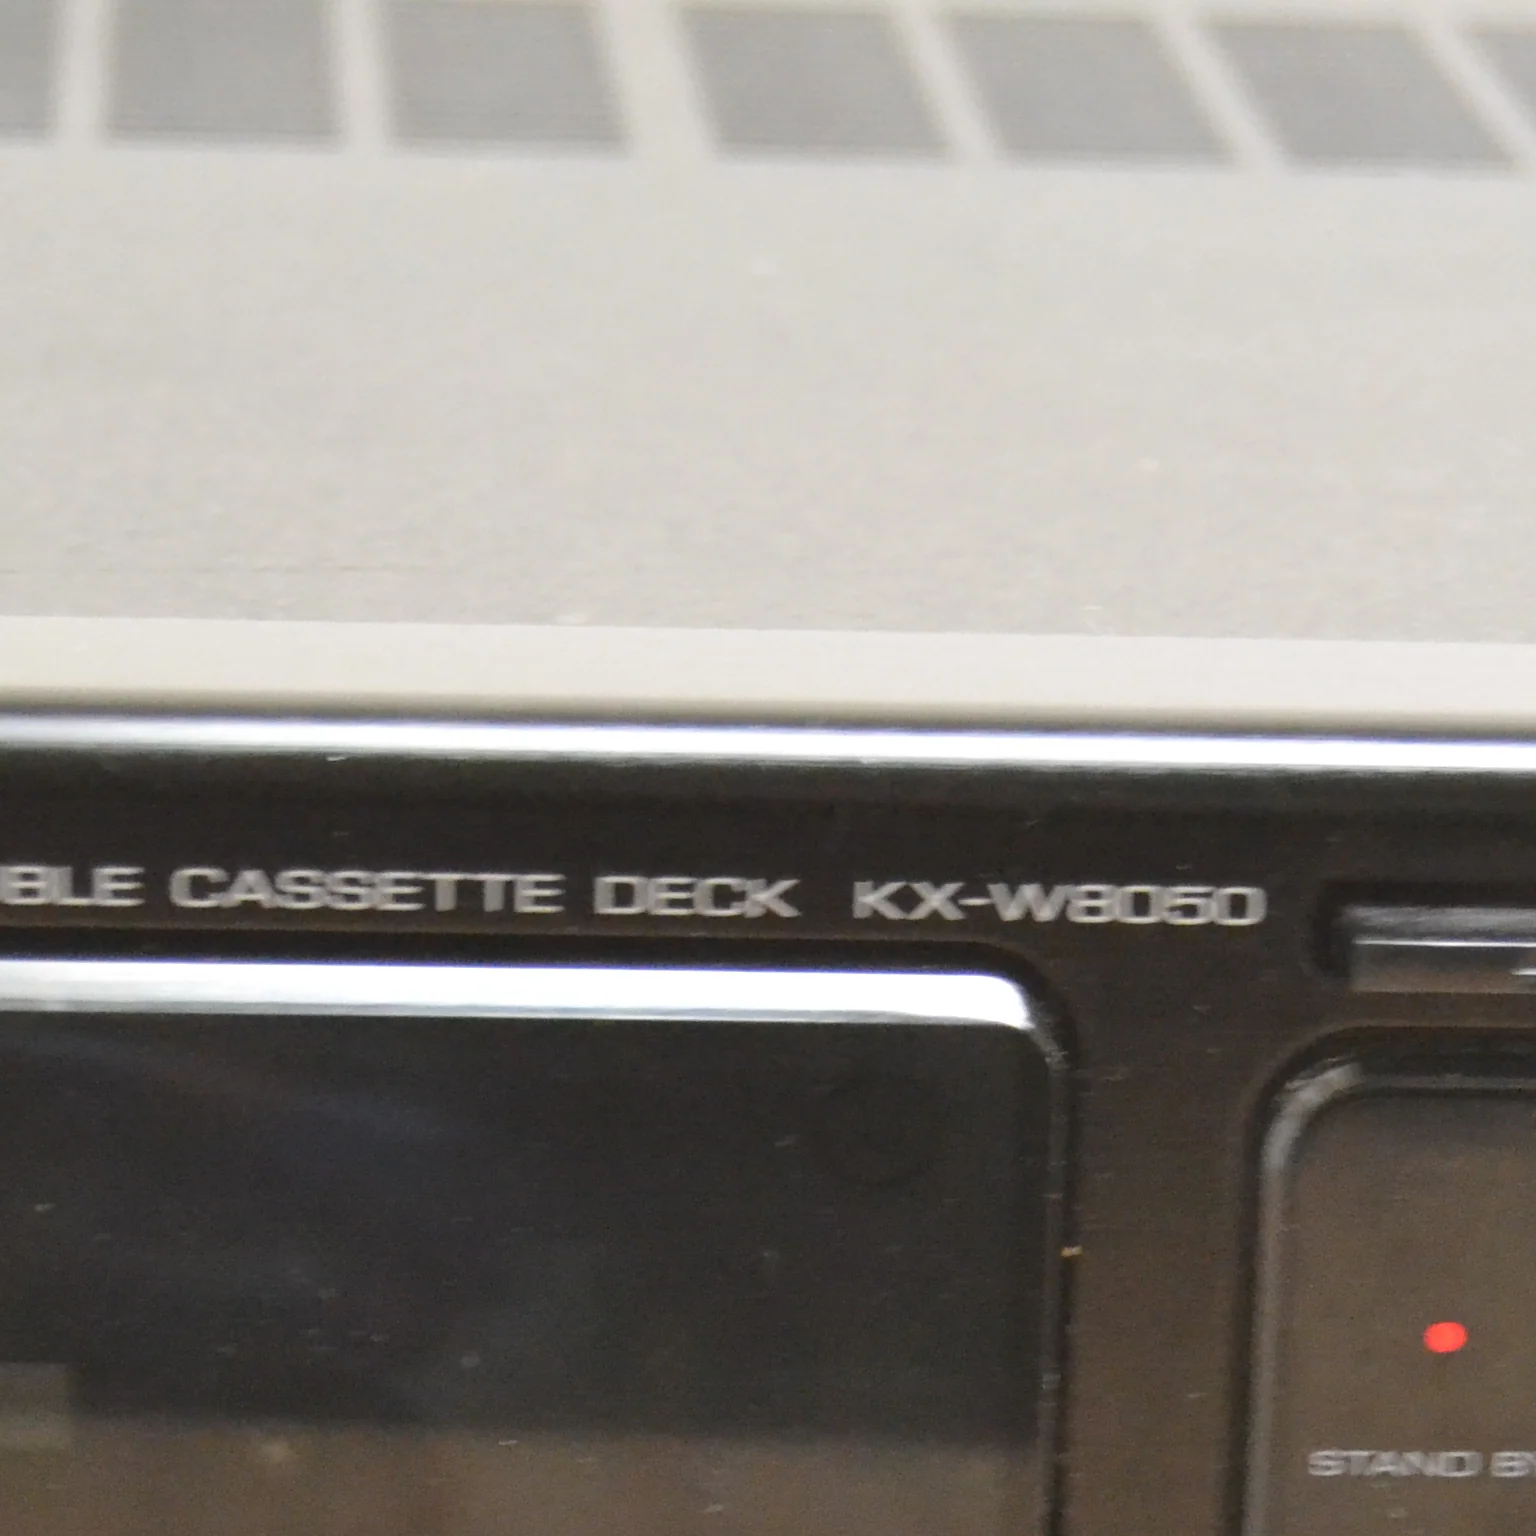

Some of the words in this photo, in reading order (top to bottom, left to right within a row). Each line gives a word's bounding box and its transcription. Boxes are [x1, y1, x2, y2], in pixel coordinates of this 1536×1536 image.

[168, 866, 566, 916] CASSETTE
[593, 874, 800, 920] DECK
[852, 880, 1267, 928] KX-W8050
[1306, 1448, 1481, 1478] STAND
